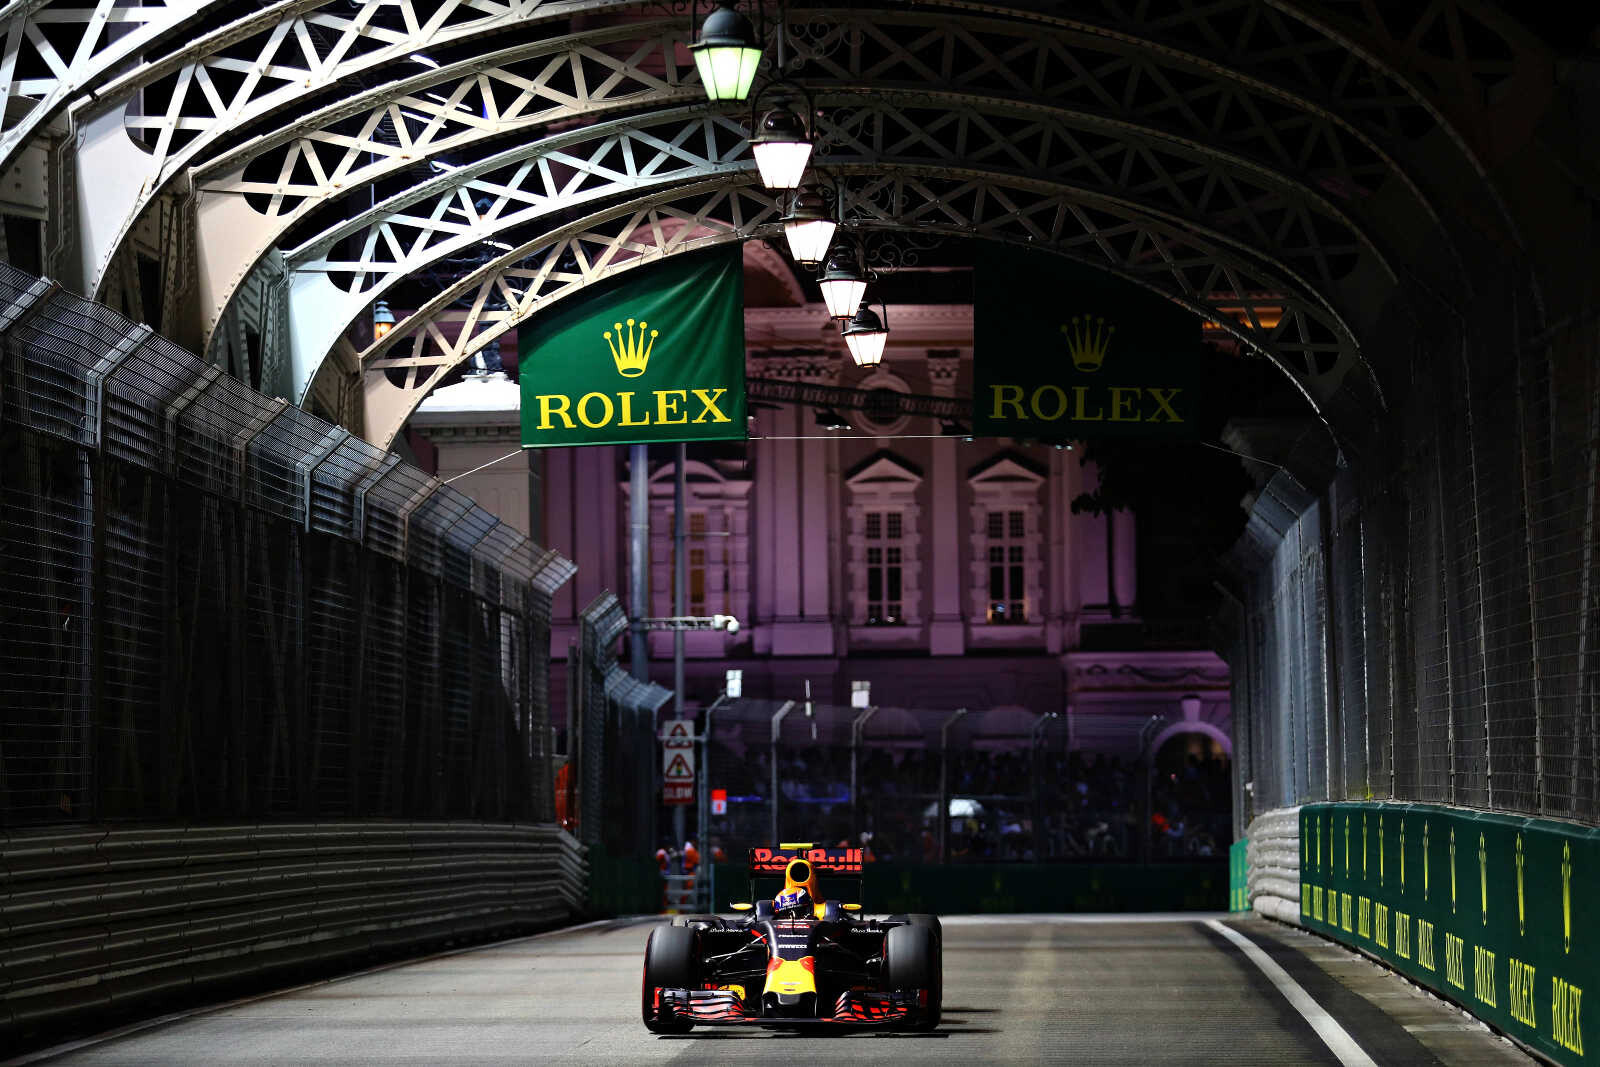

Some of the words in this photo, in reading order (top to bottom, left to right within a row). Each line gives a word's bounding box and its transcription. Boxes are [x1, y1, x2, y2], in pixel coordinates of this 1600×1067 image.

[535, 387, 732, 430] ROLEX
[988, 384, 1183, 424] ROLEX
[808, 848, 862, 872] Bull
[1474, 945, 1497, 1008] ROLEX
[1509, 958, 1537, 1029] ROLEX
[1552, 976, 1584, 1057] ROLEX
